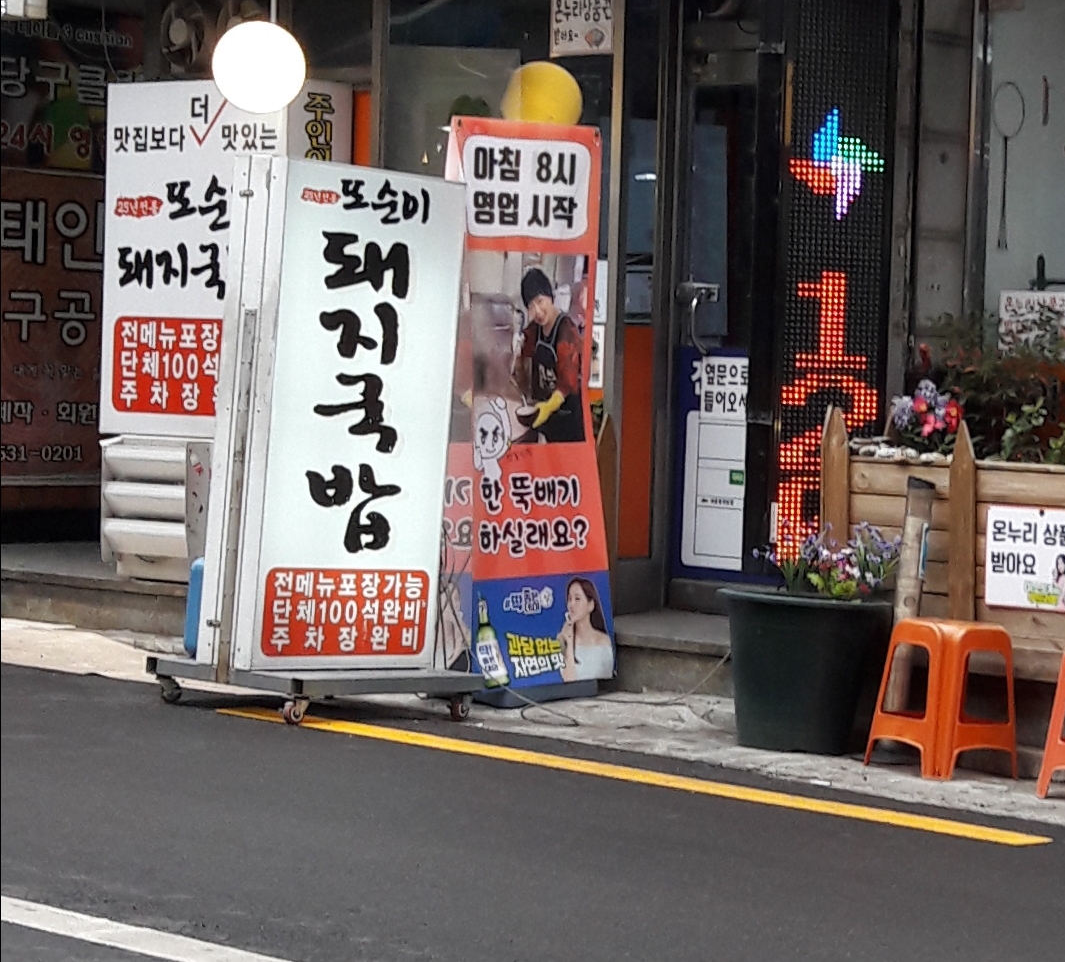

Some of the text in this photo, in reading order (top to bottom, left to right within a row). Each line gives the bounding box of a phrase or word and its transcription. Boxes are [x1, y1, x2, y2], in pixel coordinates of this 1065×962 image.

[191, 94, 209, 124] 더
[114, 122, 278, 153] 맛집보다 맛있는
[473, 146, 577, 186] 아침 8시
[165, 174, 233, 232] 또순
[341, 179, 430, 224] 또순이
[473, 192, 578, 229] 영업 시작
[118, 242, 230, 300] 돼지국
[305, 230, 411, 554] 돼지국밥
[482, 476, 503, 511] 한
[510, 475, 579, 511] 뚝배기
[481, 518, 588, 554] 하실래요?
[992, 520, 1037, 545] 온누리
[991, 551, 1036, 575] 받아요
[274, 571, 424, 599] 전메뉴포장가능
[272, 599, 421, 625] 단체100석완비
[510, 655, 551, 679] 자연의
